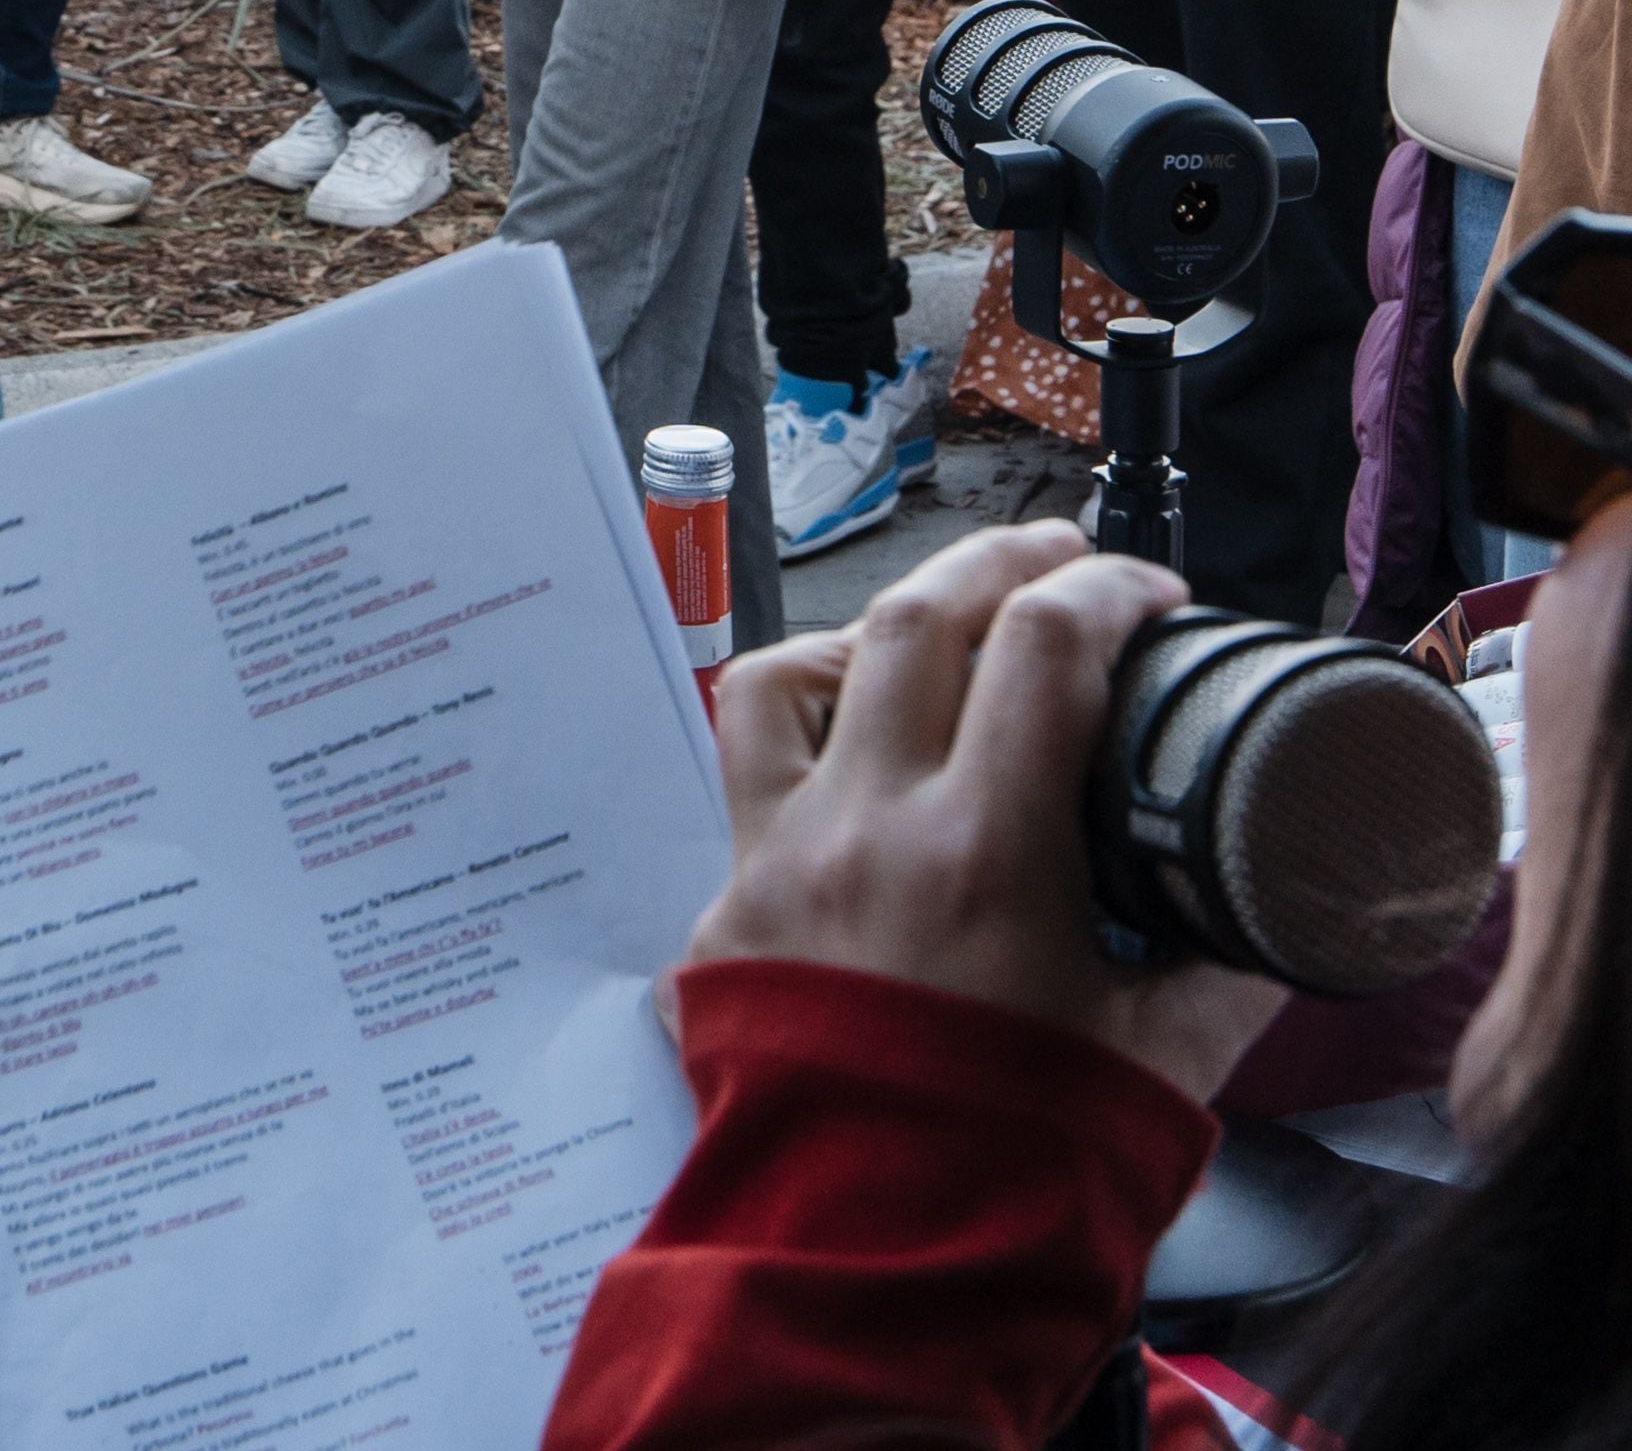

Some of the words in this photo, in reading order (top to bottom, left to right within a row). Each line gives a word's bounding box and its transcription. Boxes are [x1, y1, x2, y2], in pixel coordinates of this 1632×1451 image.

[1163, 153, 1236, 171] PODMIC
[66, 1405, 95, 1421] True
[98, 1391, 139, 1410] Italian
[142, 1370, 207, 1397] Questions
[210, 1356, 248, 1374] Game
